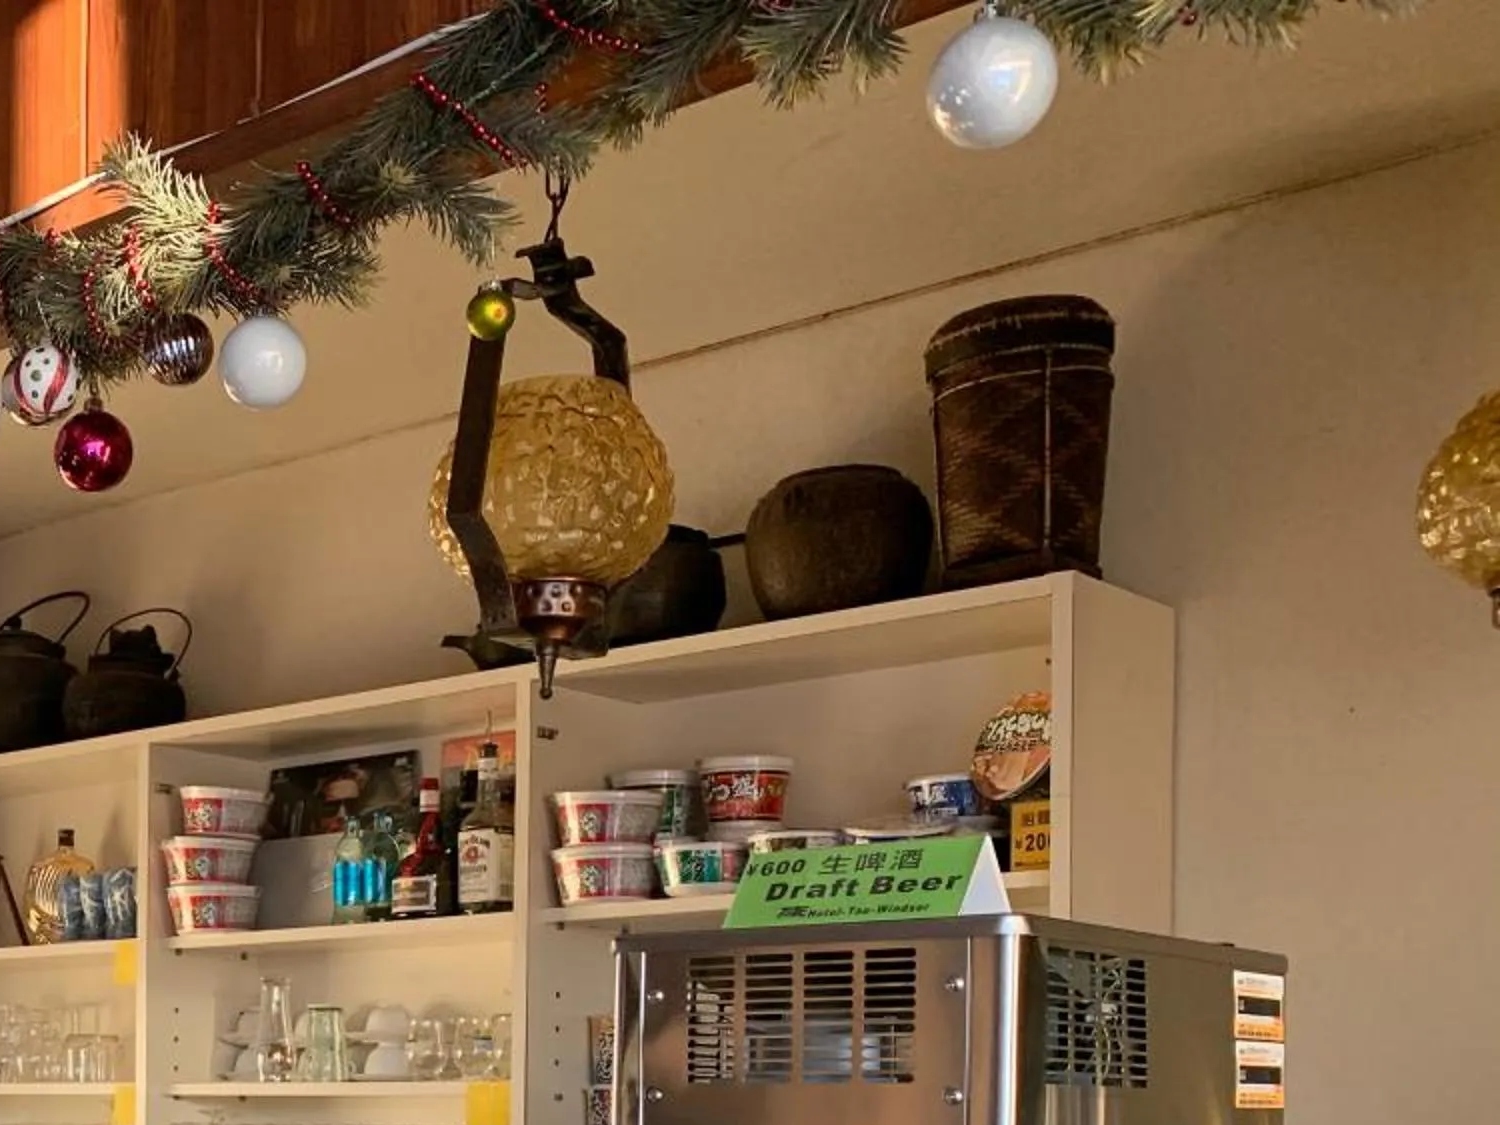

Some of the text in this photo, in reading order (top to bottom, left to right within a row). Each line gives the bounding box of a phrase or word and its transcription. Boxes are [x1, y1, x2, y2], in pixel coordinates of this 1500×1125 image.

[1014, 832, 1051, 853] ¥20
[746, 859, 806, 877] ¥600
[818, 848, 925, 875] 生啤酒
[765, 875, 963, 902] Draft Beer
